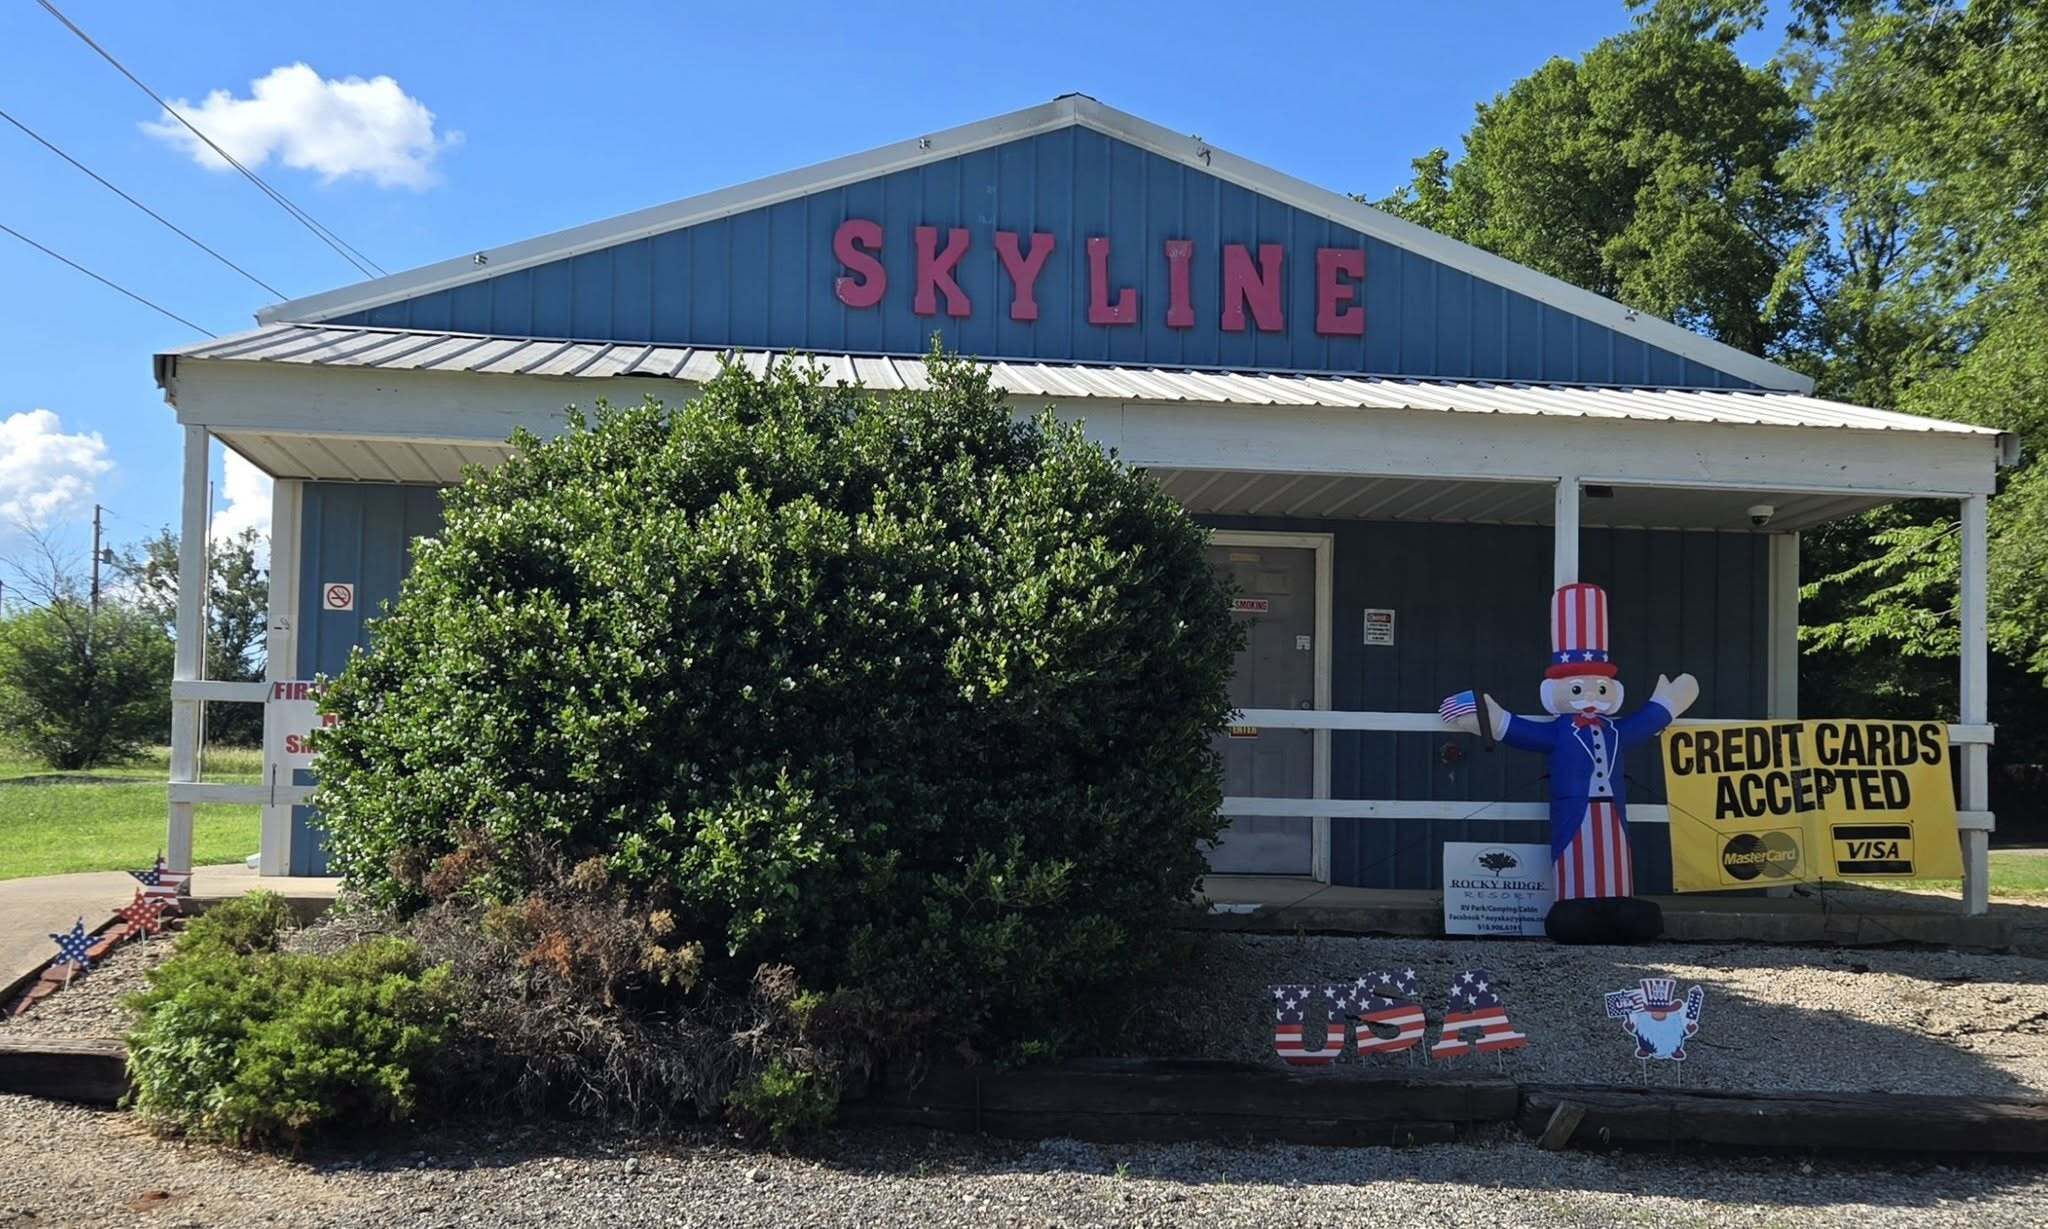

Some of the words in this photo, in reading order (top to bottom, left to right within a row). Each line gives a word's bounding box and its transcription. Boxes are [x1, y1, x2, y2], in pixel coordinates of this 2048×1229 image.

[833, 219, 1365, 335] SKYLINE
[1235, 600, 1267, 610] SMOKING
[1670, 722, 1804, 776] CREDIT
[1815, 723, 1942, 766] CARDS
[1715, 768, 1911, 820] ACCEPTED
[1724, 848, 1797, 866] MasterCard
[1847, 841, 1900, 860] VISA
[1451, 879, 1498, 889] ROCKY
[1503, 880, 1546, 891] RIDGE
[1464, 891, 1536, 900] RESORT
[1460, 904, 1470, 912] RV
[1449, 913, 1480, 921] Facebook
[1615, 997, 1634, 1009] USA
[1267, 967, 1530, 1067] USA
